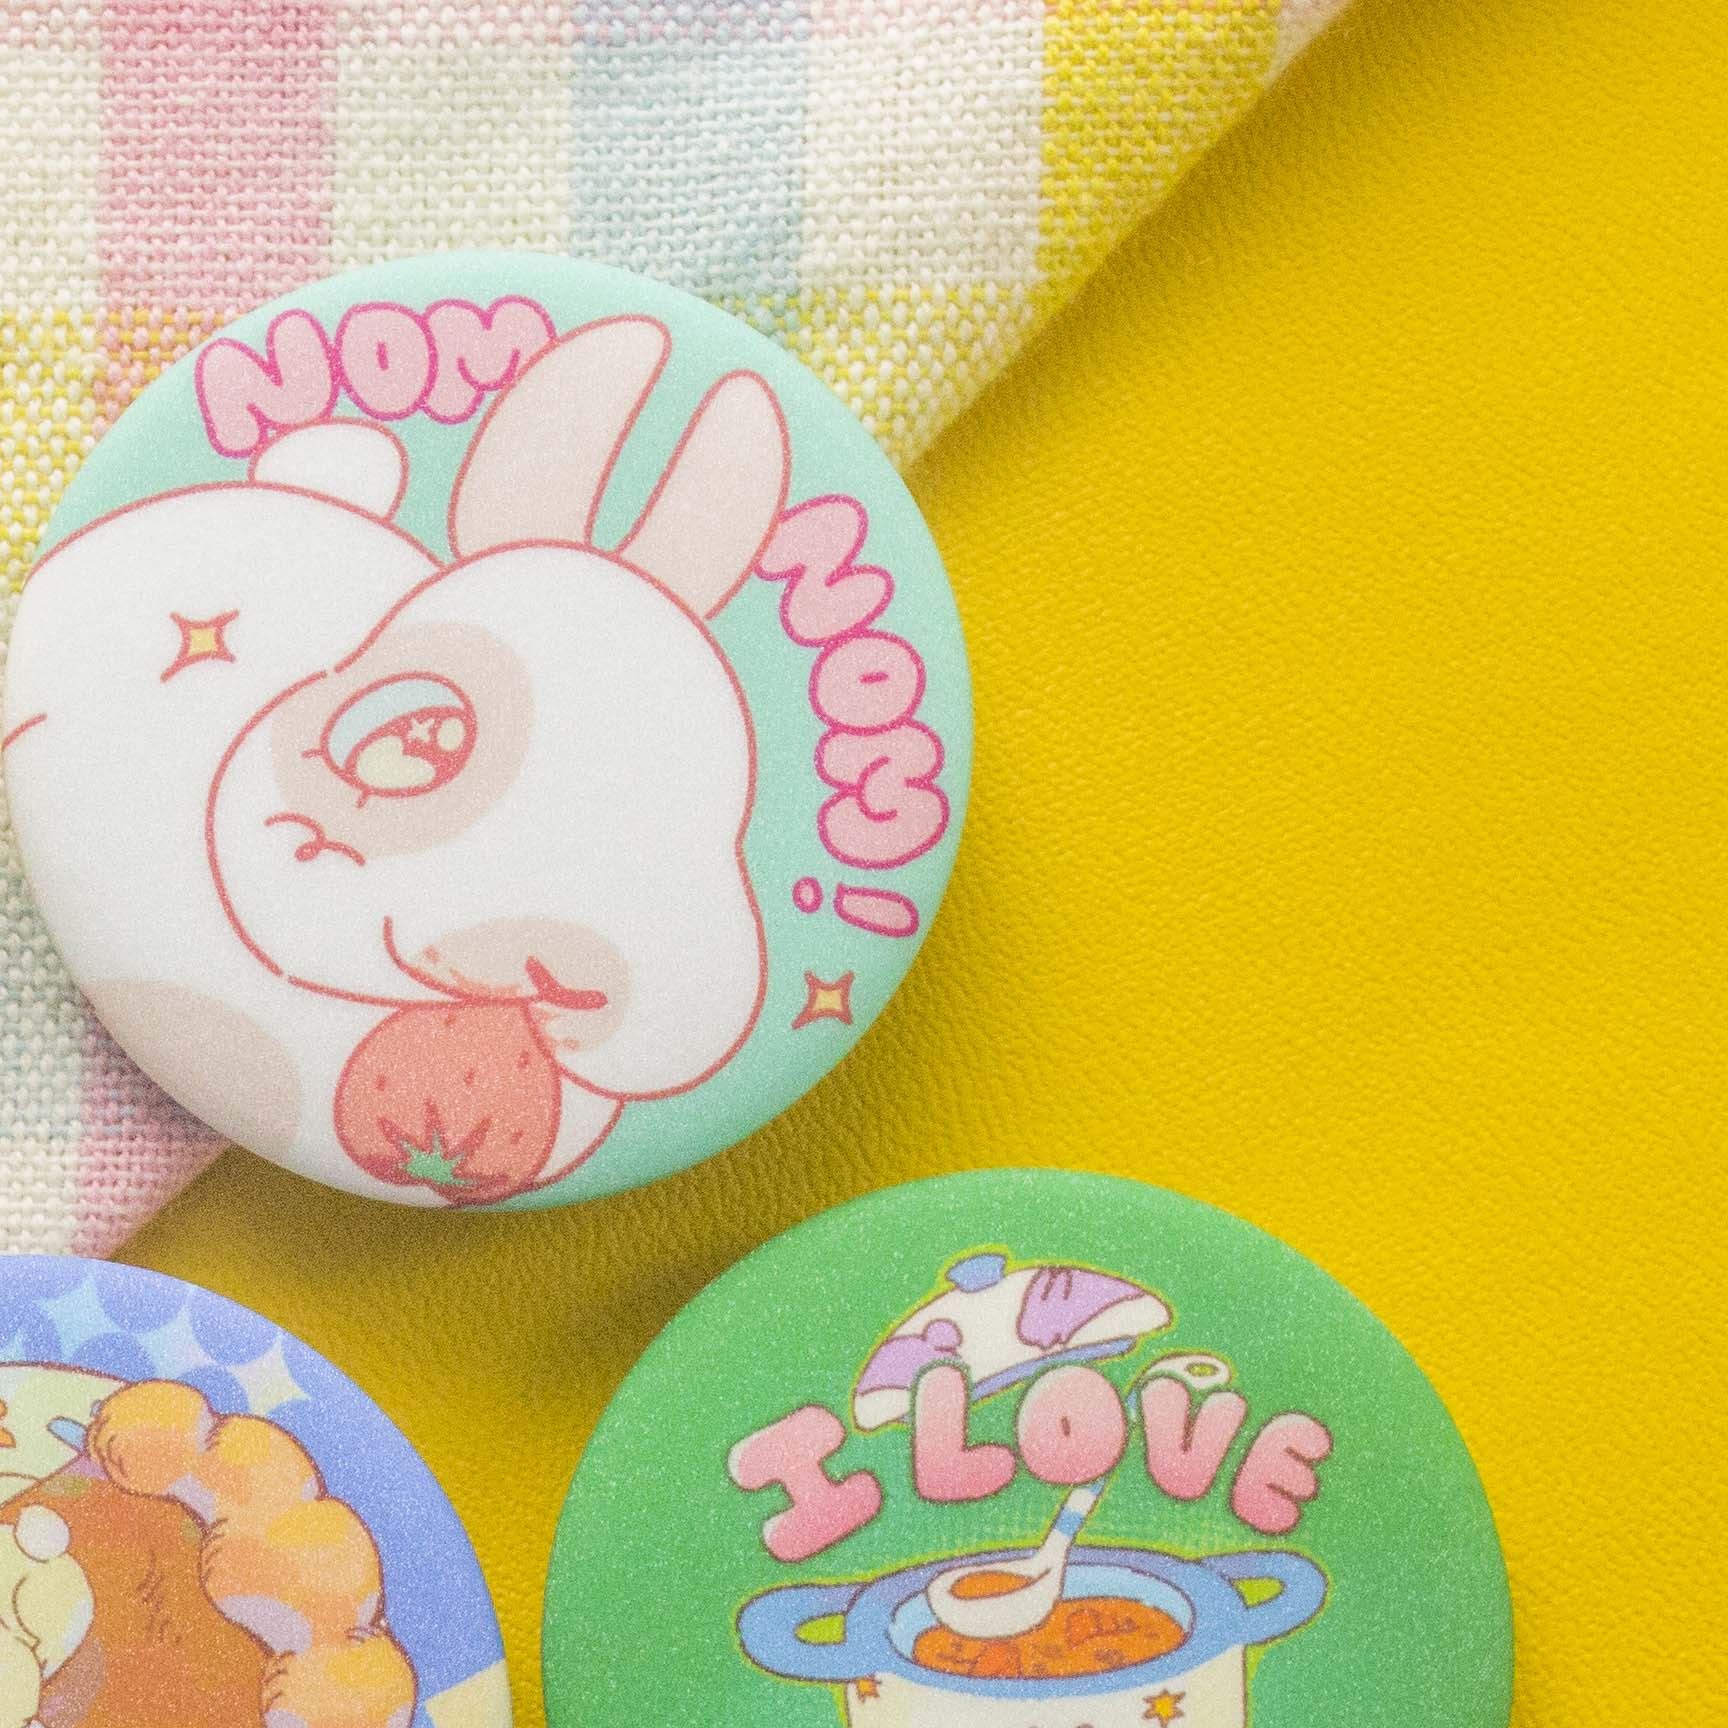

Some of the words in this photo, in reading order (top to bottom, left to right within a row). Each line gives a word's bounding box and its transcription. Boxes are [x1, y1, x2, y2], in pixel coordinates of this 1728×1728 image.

[194, 295, 556, 459] NOM
[754, 494, 950, 937] NOM!
[727, 1404, 882, 1563] I
[912, 1359, 1334, 1535] LOVE
